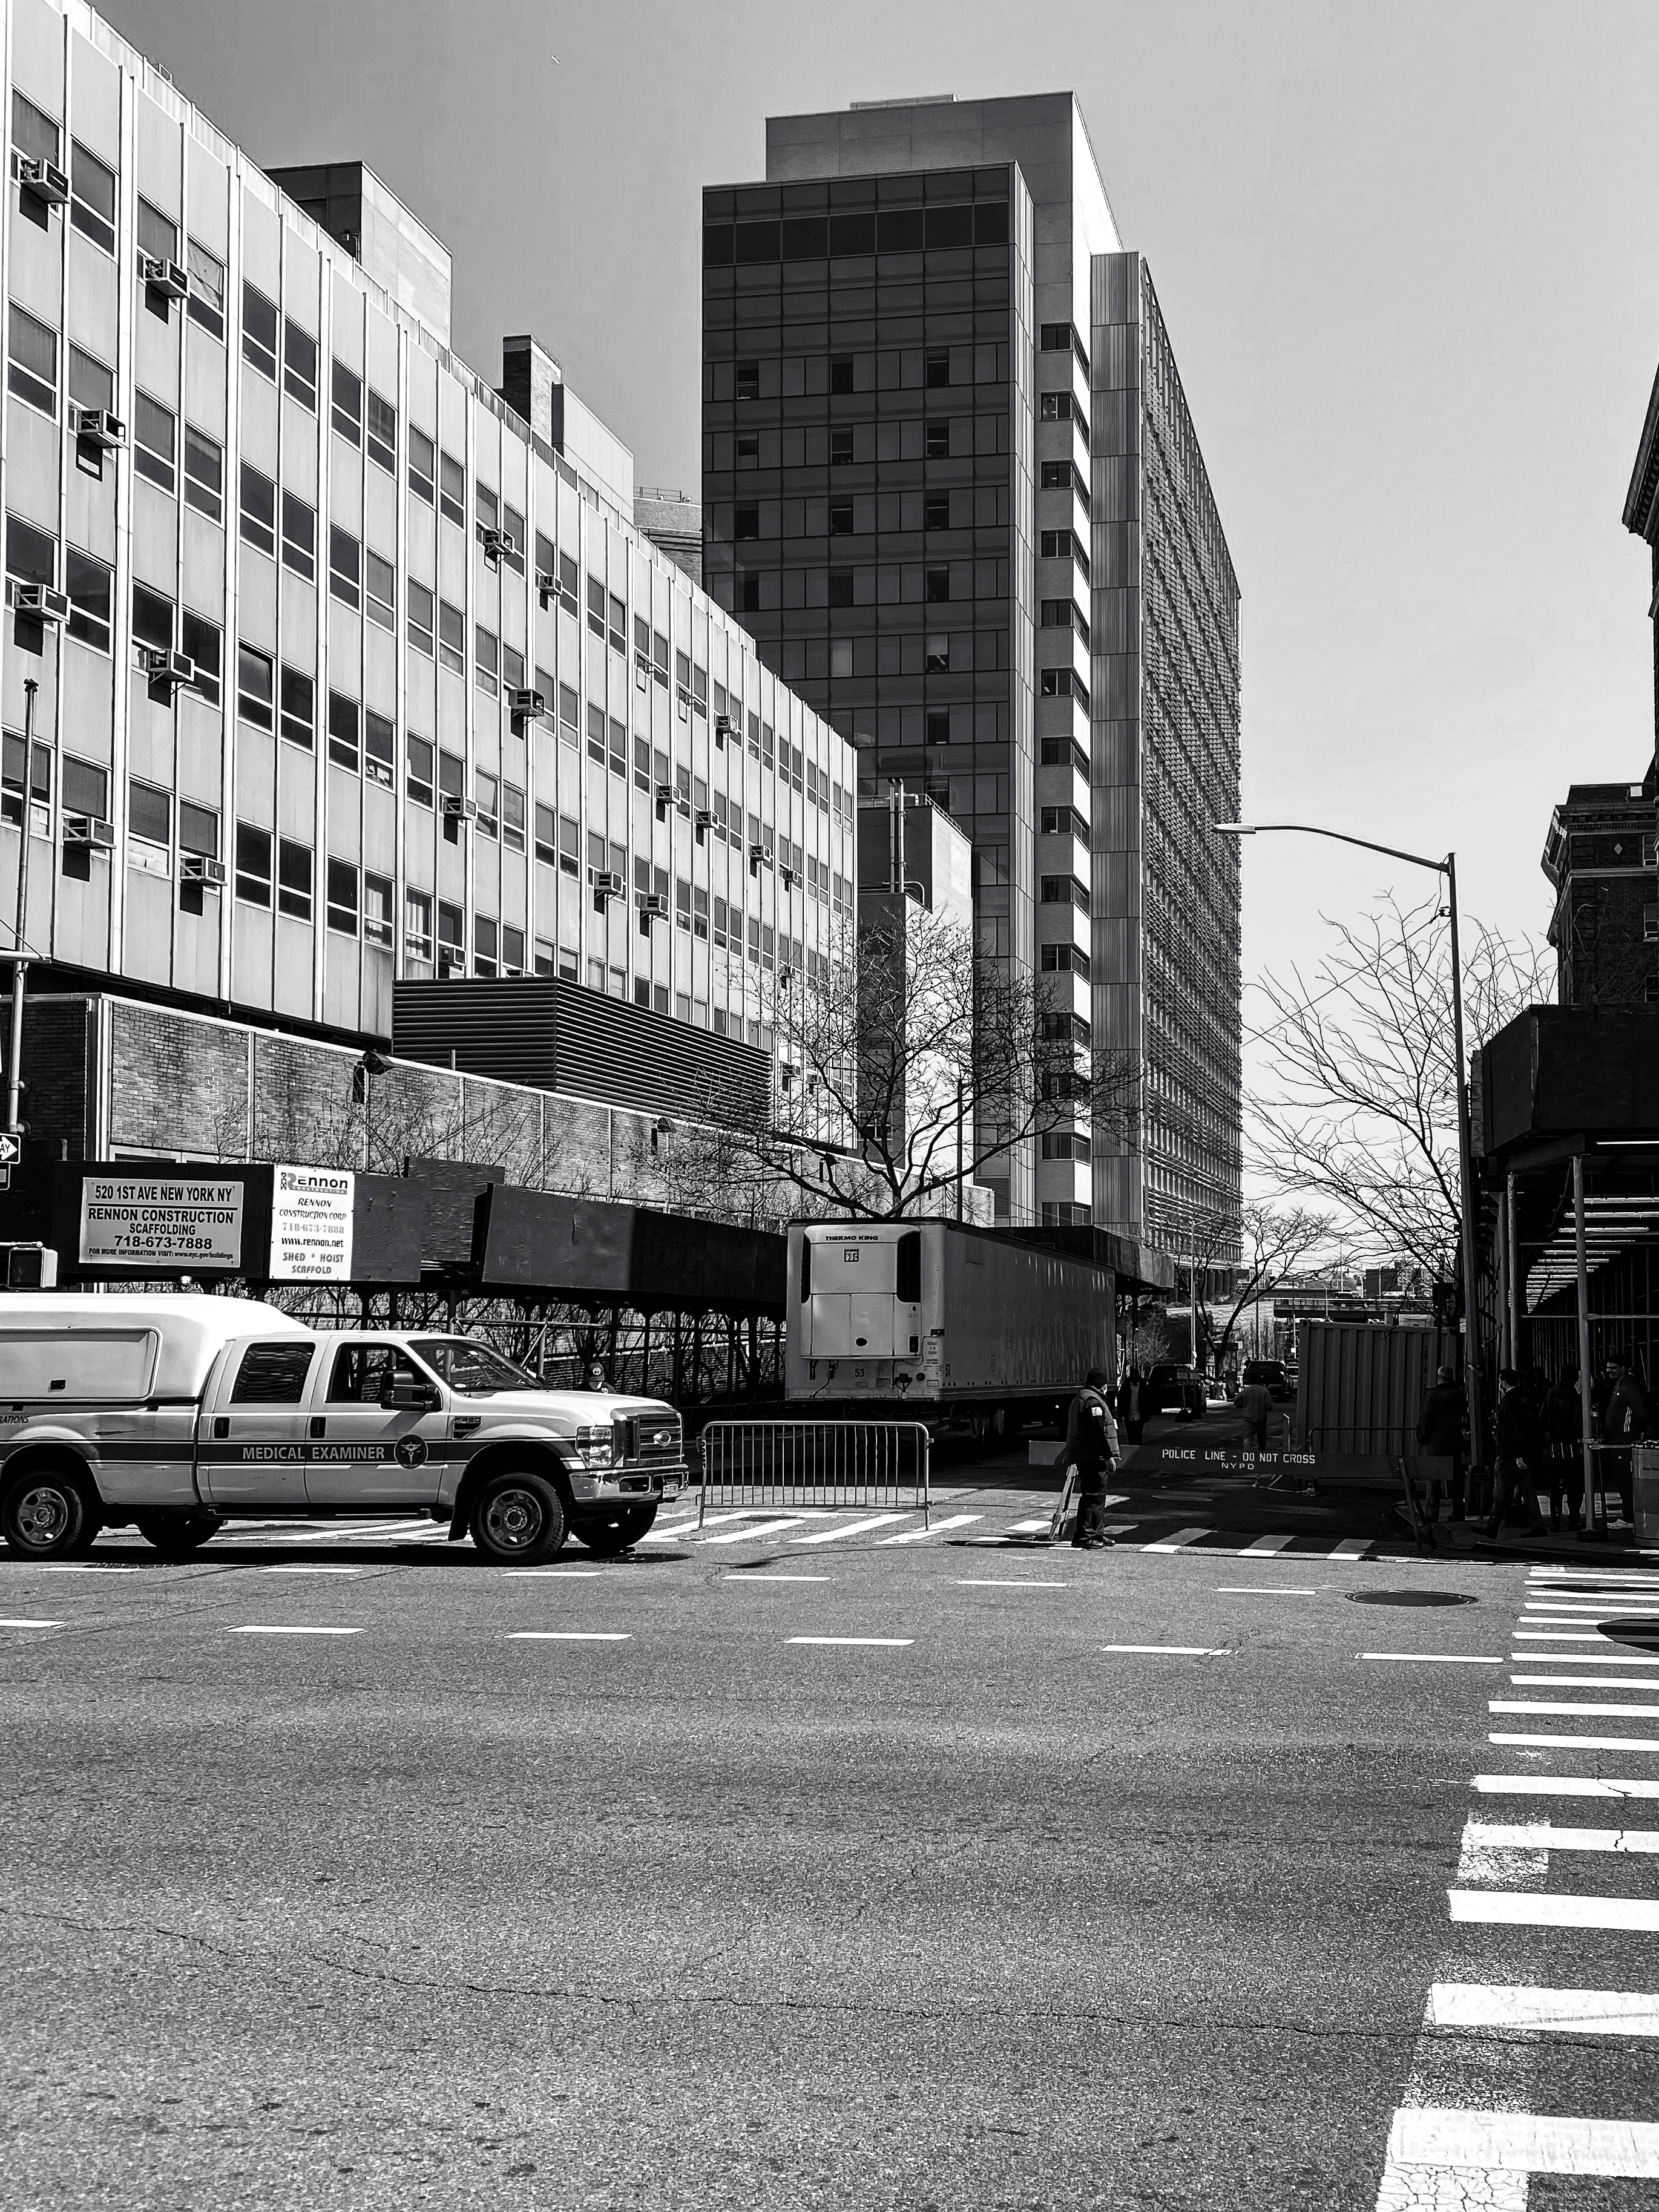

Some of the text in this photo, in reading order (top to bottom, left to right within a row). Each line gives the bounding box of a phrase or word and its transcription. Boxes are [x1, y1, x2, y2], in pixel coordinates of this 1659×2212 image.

[95, 1185, 232, 1202] 520 1ST AVE NEW YORK NY
[298, 1198, 332, 1207] RENNON
[88, 1208, 234, 1224] RENNON CONSTRUCTION
[279, 1209, 327, 1219] CONSTRUCTION
[130, 1223, 195, 1235] SCAFFOLDING
[282, 1223, 344, 1234] 718-673-7888
[114, 1235, 212, 1249] 718-673-7888
[281, 1237, 344, 1247] www.rennon.net
[283, 1252, 344, 1263] SHED HOIST
[291, 1265, 332, 1274] SCAFFOLD
[243, 1446, 385, 1460] MEDICAL EXAMINER
[1162, 1449, 1196, 1460] POLICE
[1205, 1451, 1226, 1461] LINE
[1243, 1452, 1255, 1462] DO
[1260, 1453, 1278, 1463] NOT
[1283, 1454, 1315, 1464] CROSS
